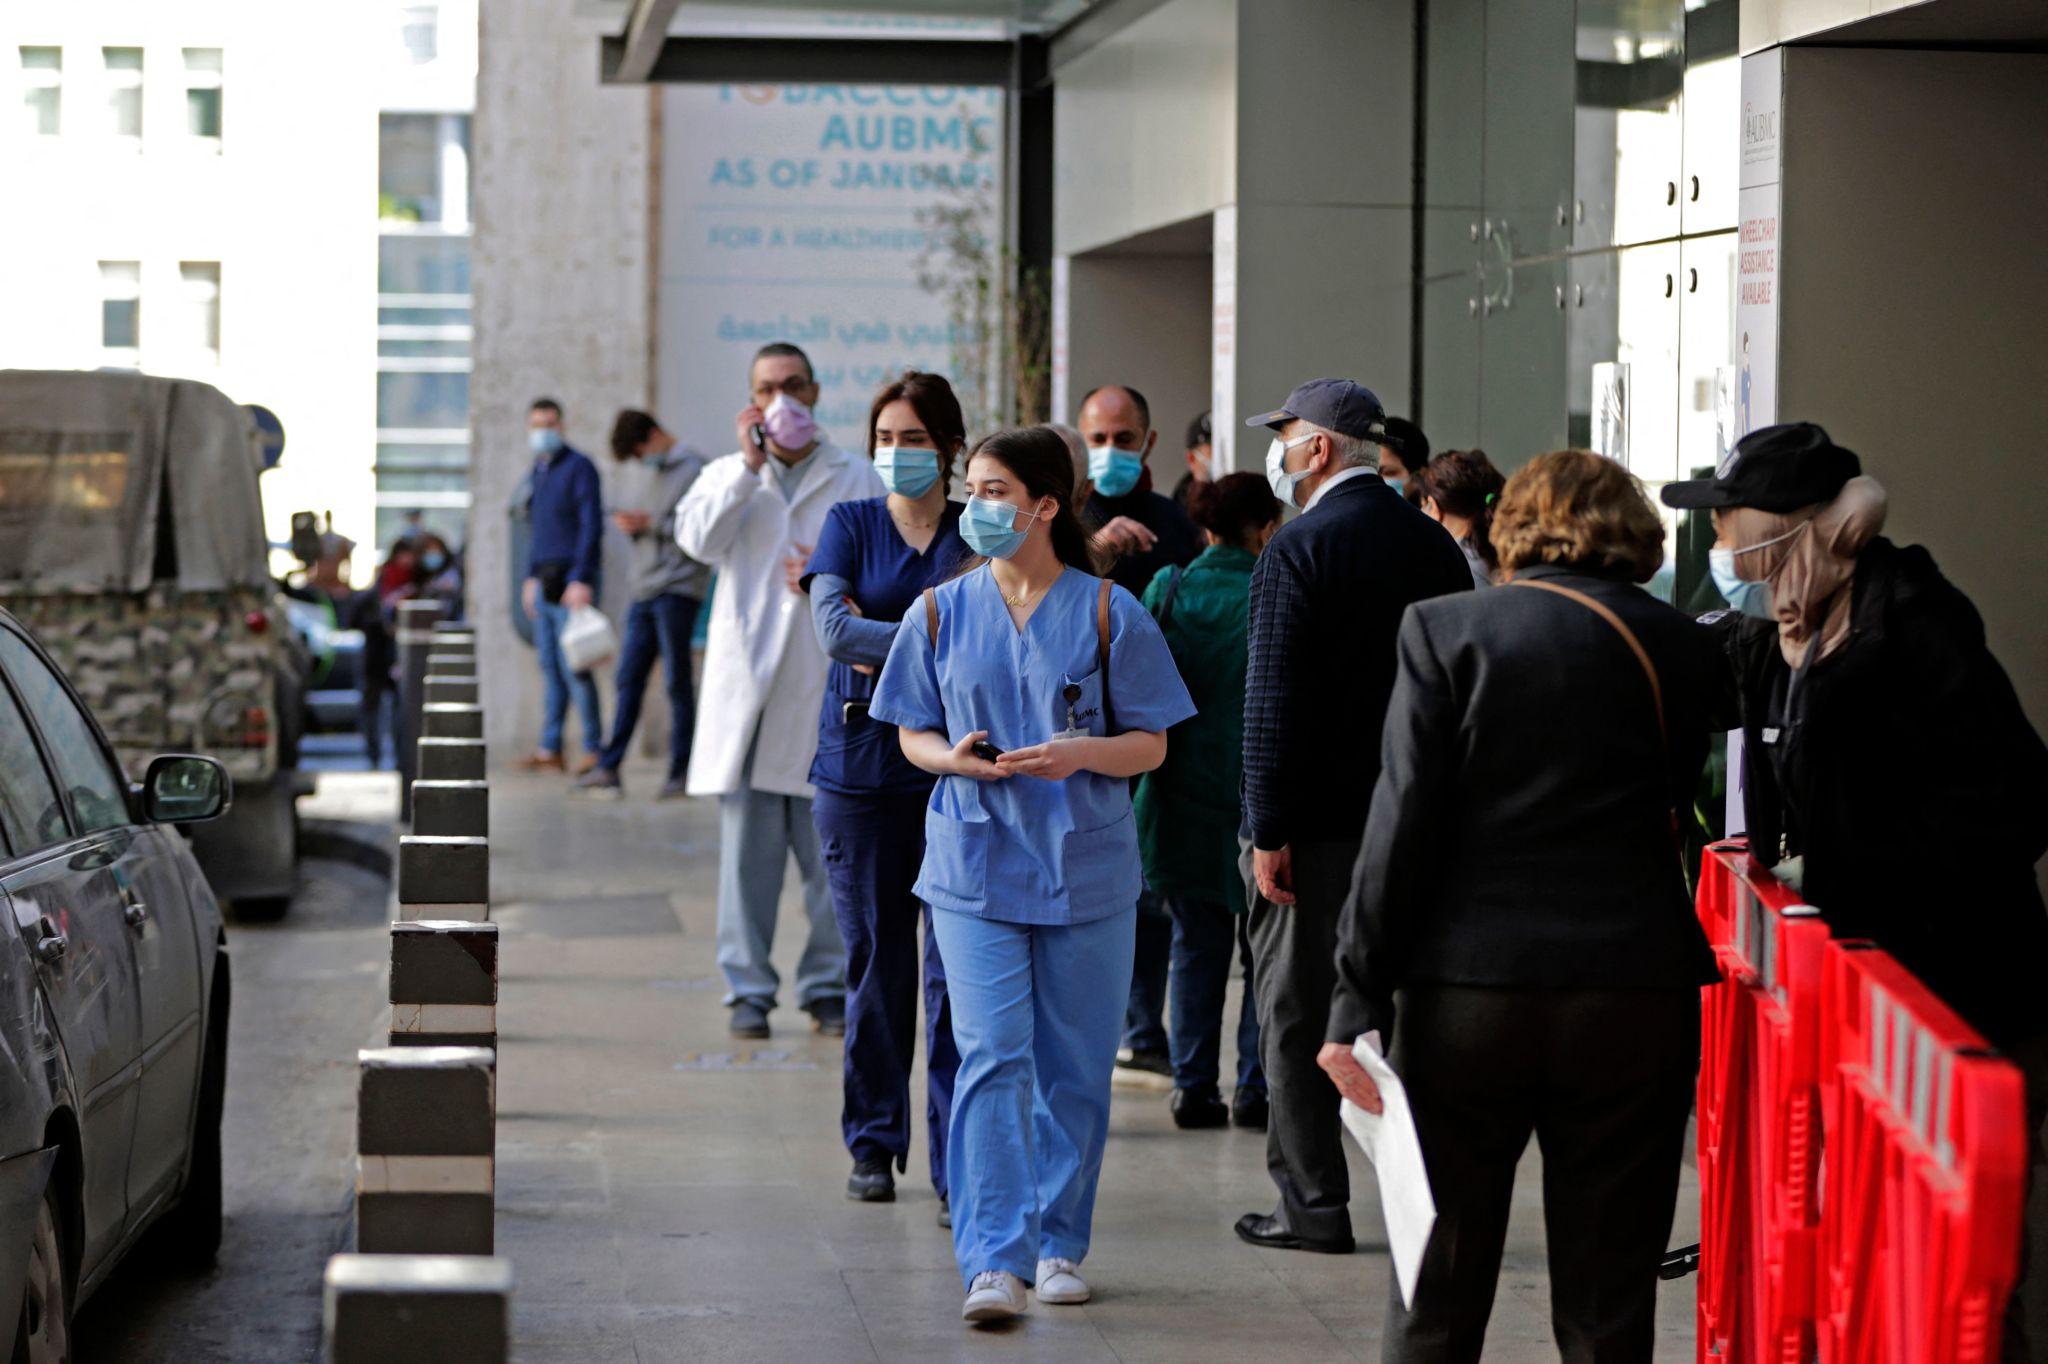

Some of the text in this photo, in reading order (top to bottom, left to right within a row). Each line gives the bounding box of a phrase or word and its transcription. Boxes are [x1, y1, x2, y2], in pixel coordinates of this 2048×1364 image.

[710, 159, 757, 187] AS
[770, 159, 818, 187] OF
[708, 225, 761, 247] FOR
[770, 226, 786, 246] A
[1740, 217, 1776, 244] WHEELCHAIR
[1740, 249, 1774, 275] ASSISTANCE
[1742, 281, 1771, 305] AVAILABLE
